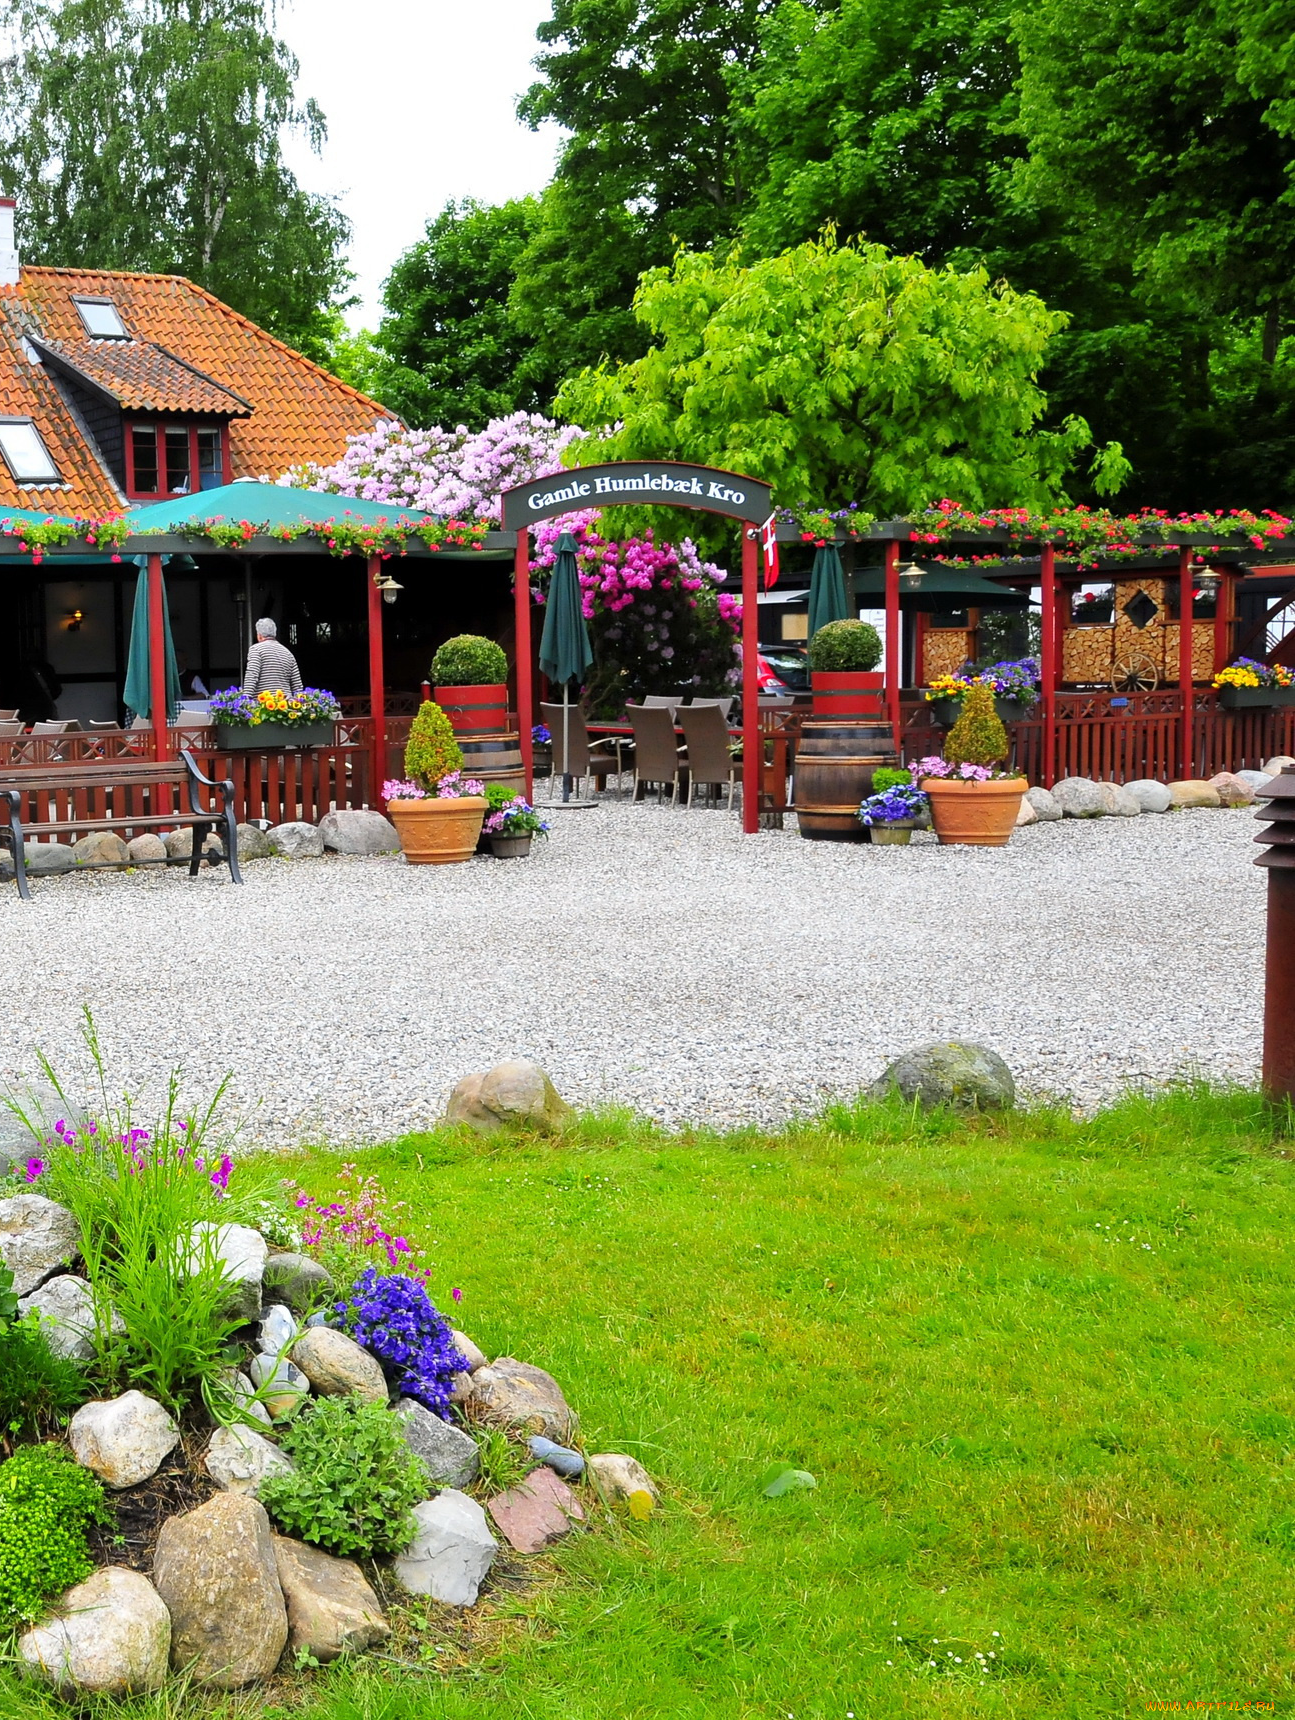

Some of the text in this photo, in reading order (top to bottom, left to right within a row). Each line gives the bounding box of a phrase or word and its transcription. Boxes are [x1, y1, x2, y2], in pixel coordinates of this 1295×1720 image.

[528, 473, 745, 510] Gamle Humlebæk Kro
